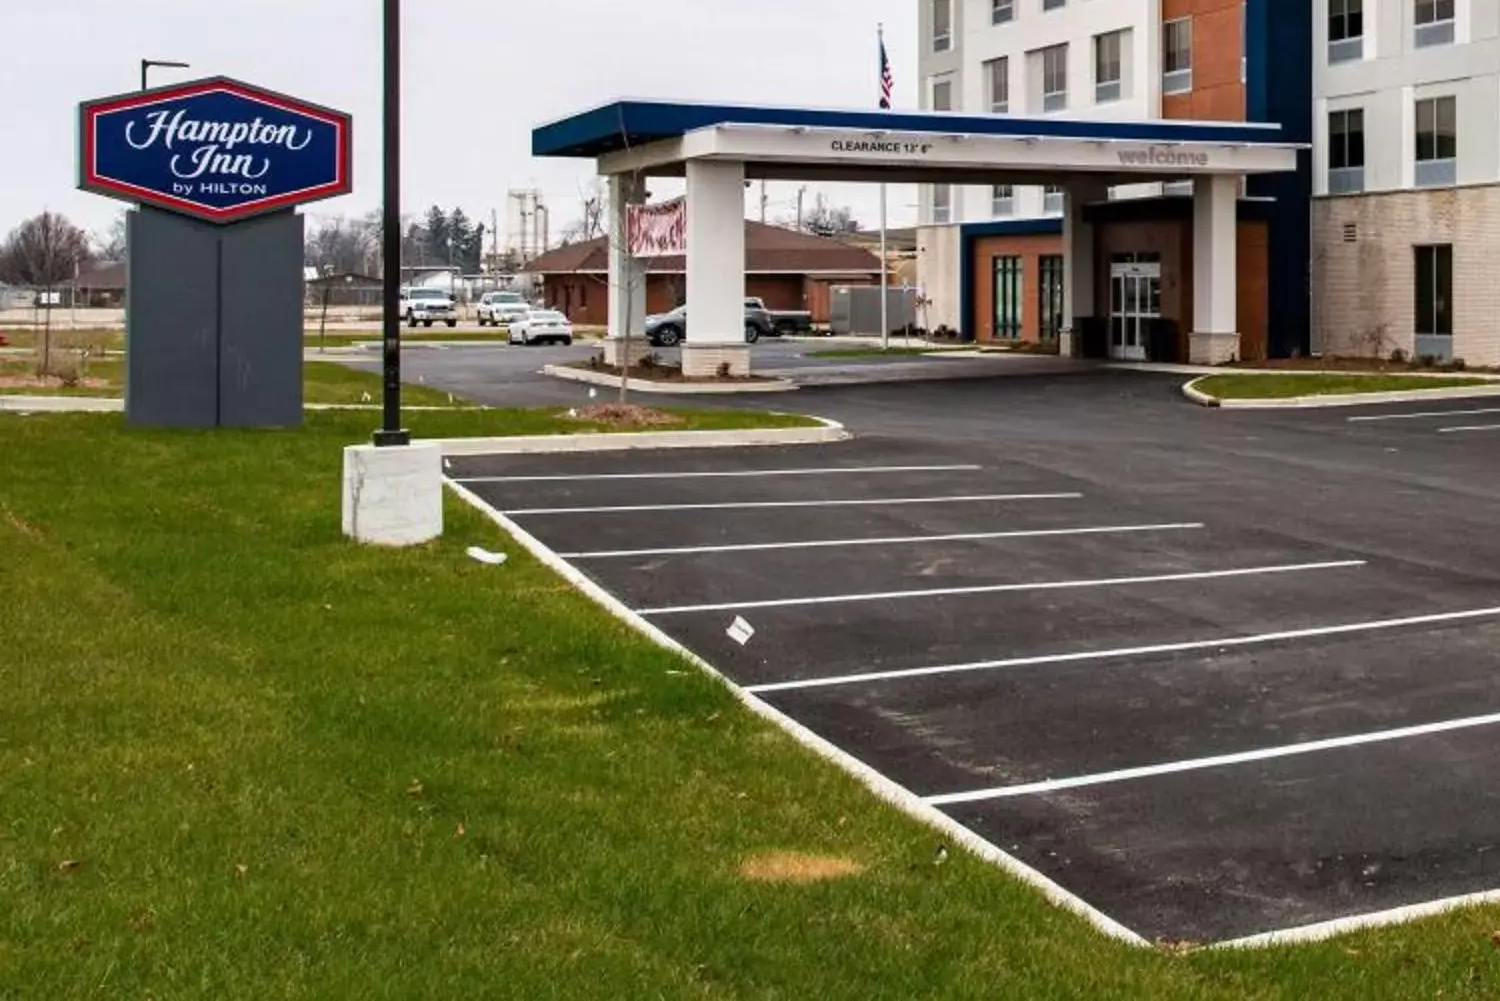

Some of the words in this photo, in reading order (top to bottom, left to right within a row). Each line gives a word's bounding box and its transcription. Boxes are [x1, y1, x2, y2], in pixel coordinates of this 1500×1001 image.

[125, 108, 312, 150] Hampton
[831, 140, 901, 153] CLEARANCE
[1117, 146, 1208, 166] welcome
[170, 144, 270, 179] Inn
[172, 183, 193, 196] by
[200, 182, 268, 195] HILTON
